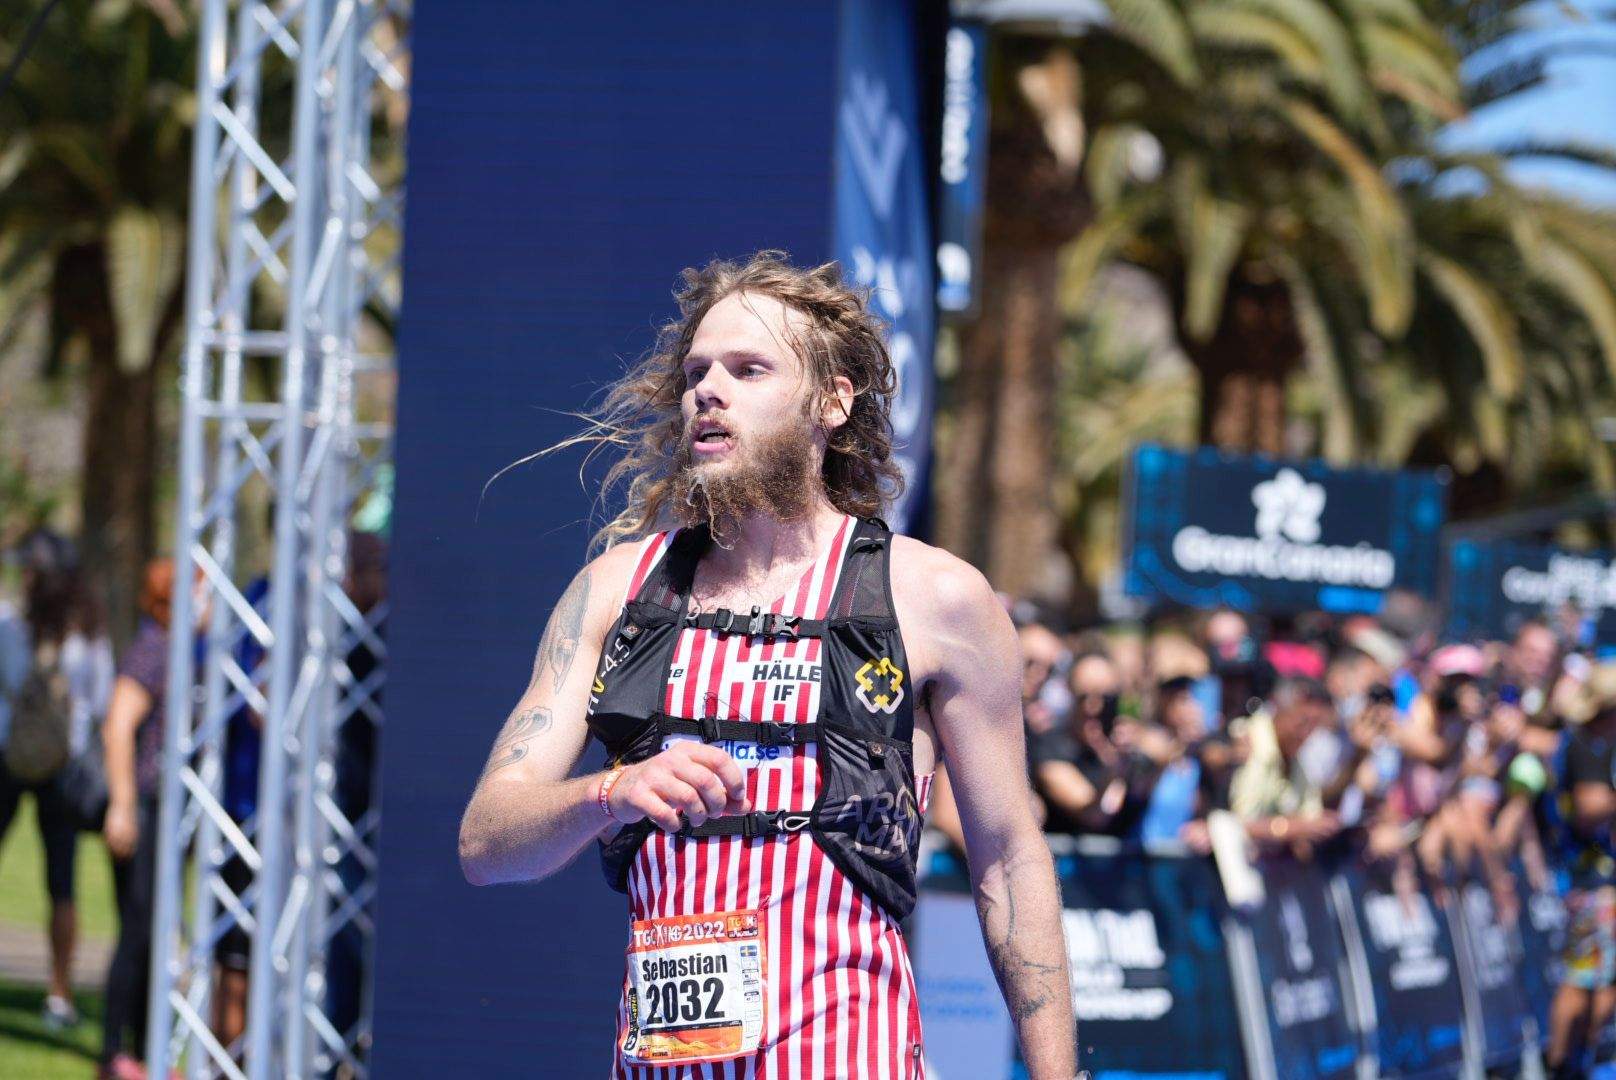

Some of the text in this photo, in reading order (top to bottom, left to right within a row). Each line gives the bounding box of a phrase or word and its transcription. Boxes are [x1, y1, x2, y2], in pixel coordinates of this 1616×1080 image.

[752, 660, 823, 682] HÄLLE
[773, 684, 795, 701] IF
[642, 953, 728, 982] Sebastian
[646, 977, 725, 1024] 2032
